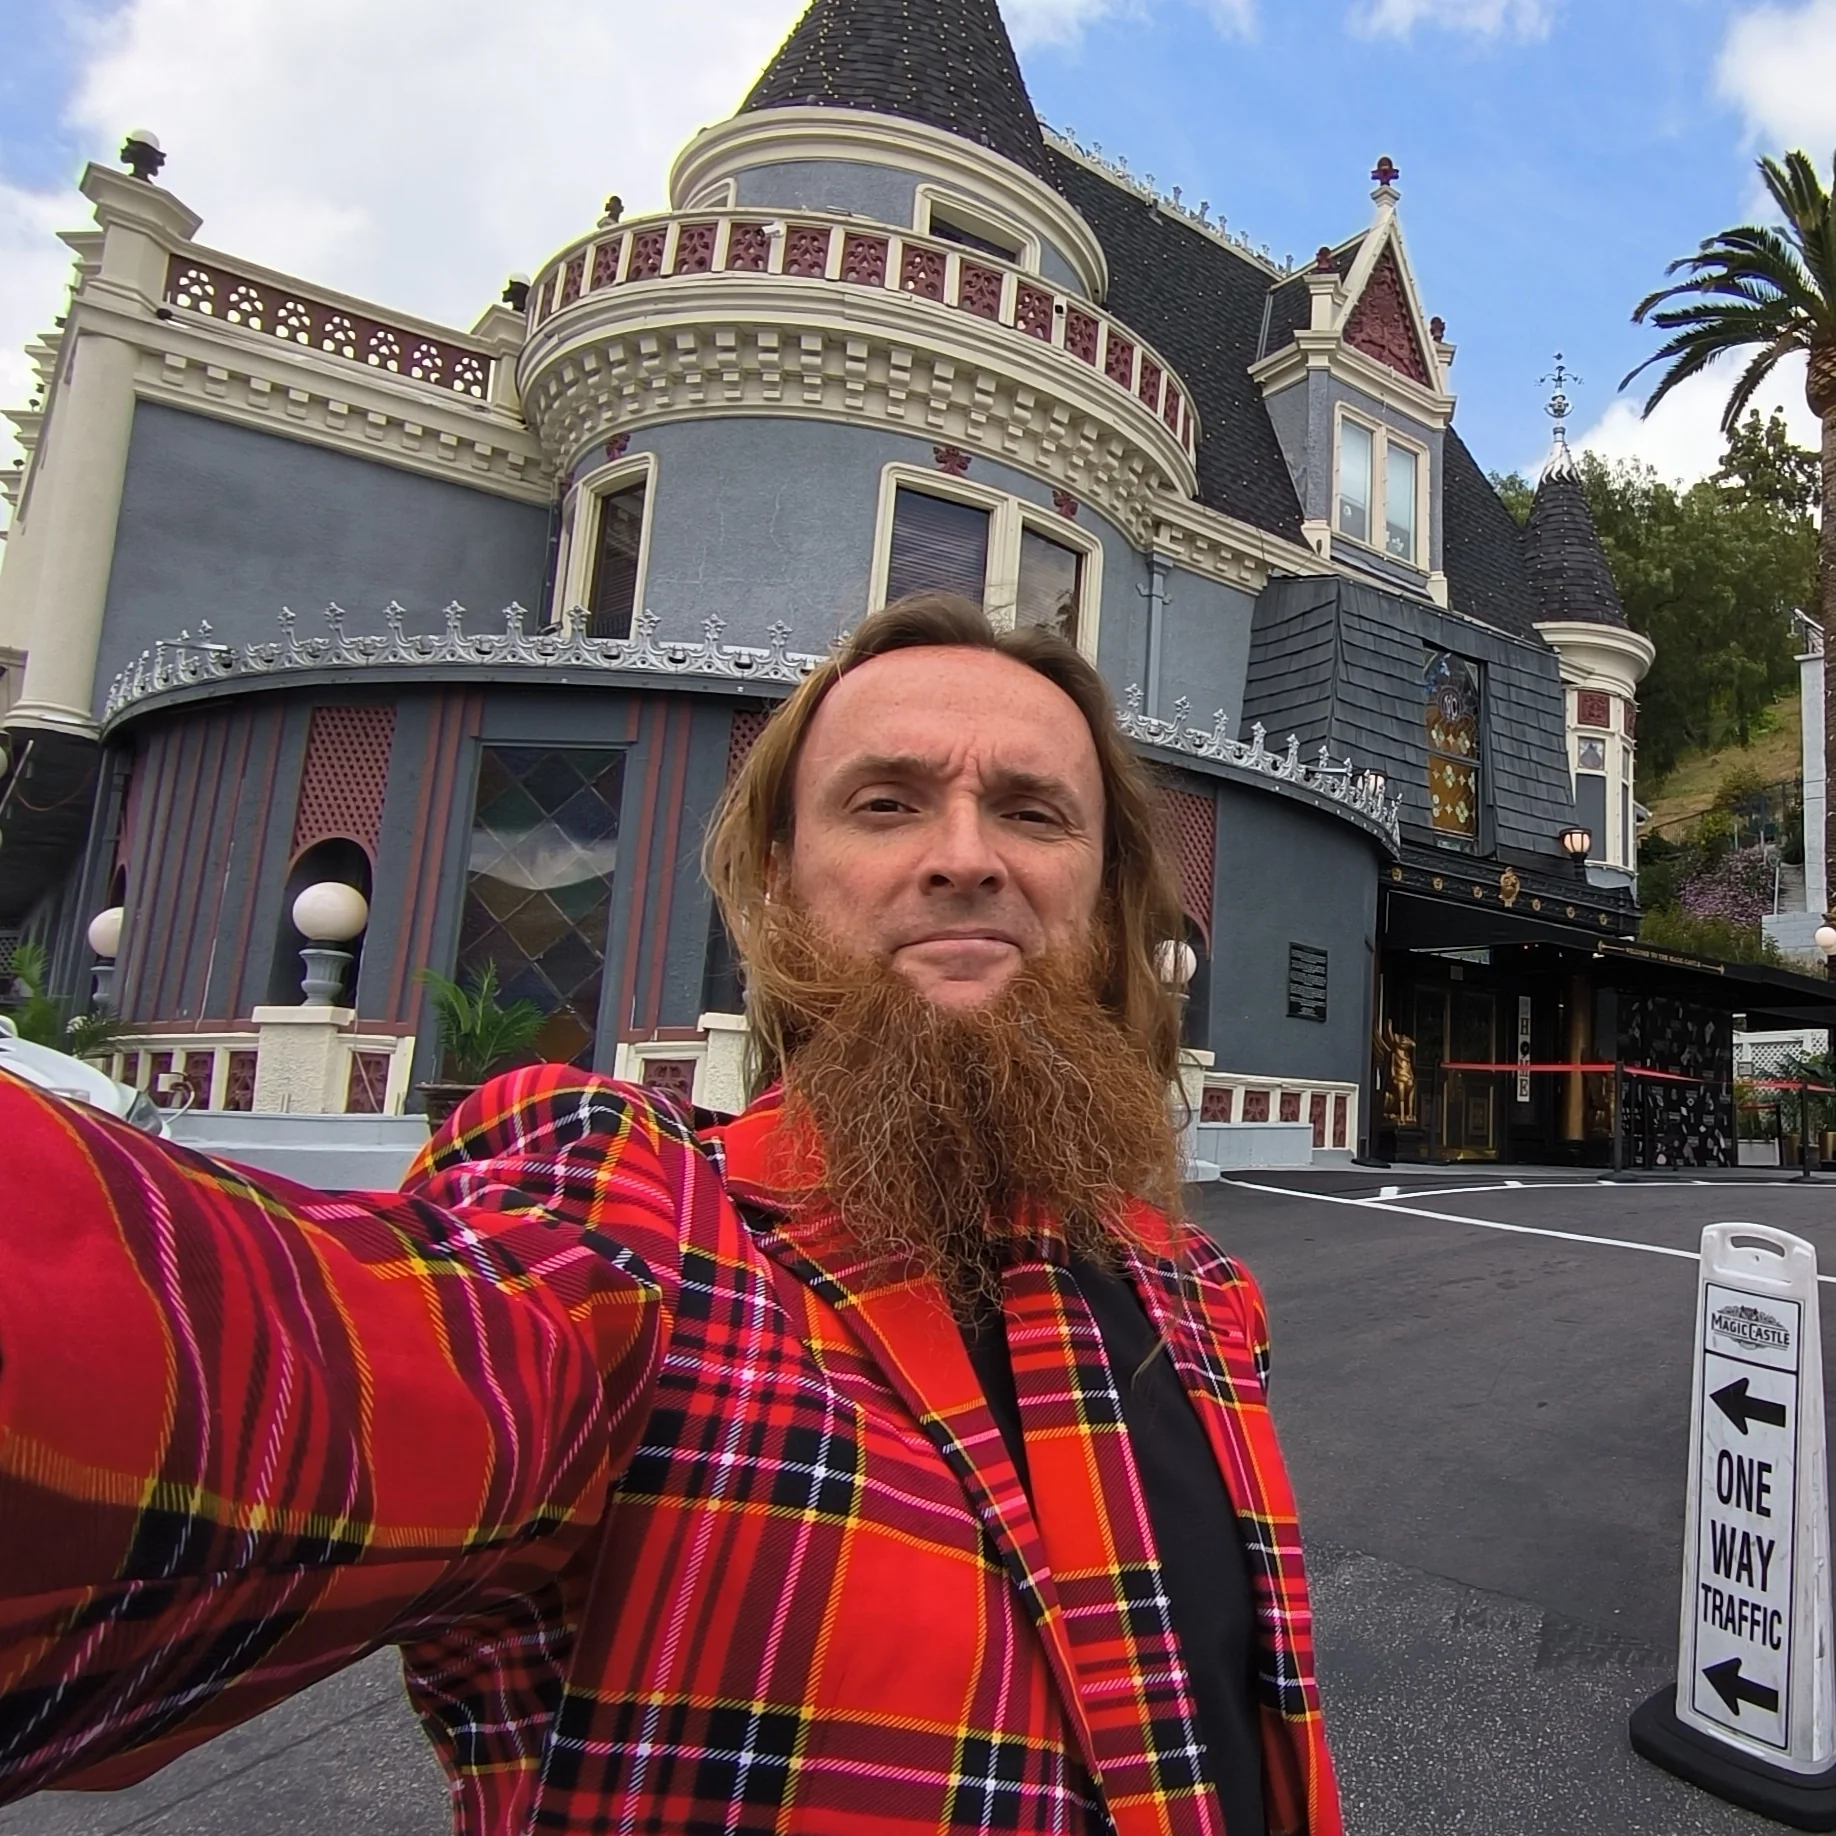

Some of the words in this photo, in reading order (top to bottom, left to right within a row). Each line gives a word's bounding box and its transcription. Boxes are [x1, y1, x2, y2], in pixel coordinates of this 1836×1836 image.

[1711, 1313, 1747, 1336] MAGIC
[1749, 1323, 1790, 1345] CASTLE
[1716, 1449, 1772, 1518] ONE
[1711, 1519, 1775, 1592] WAY
[1701, 1583, 1782, 1650] TRAFFIC
